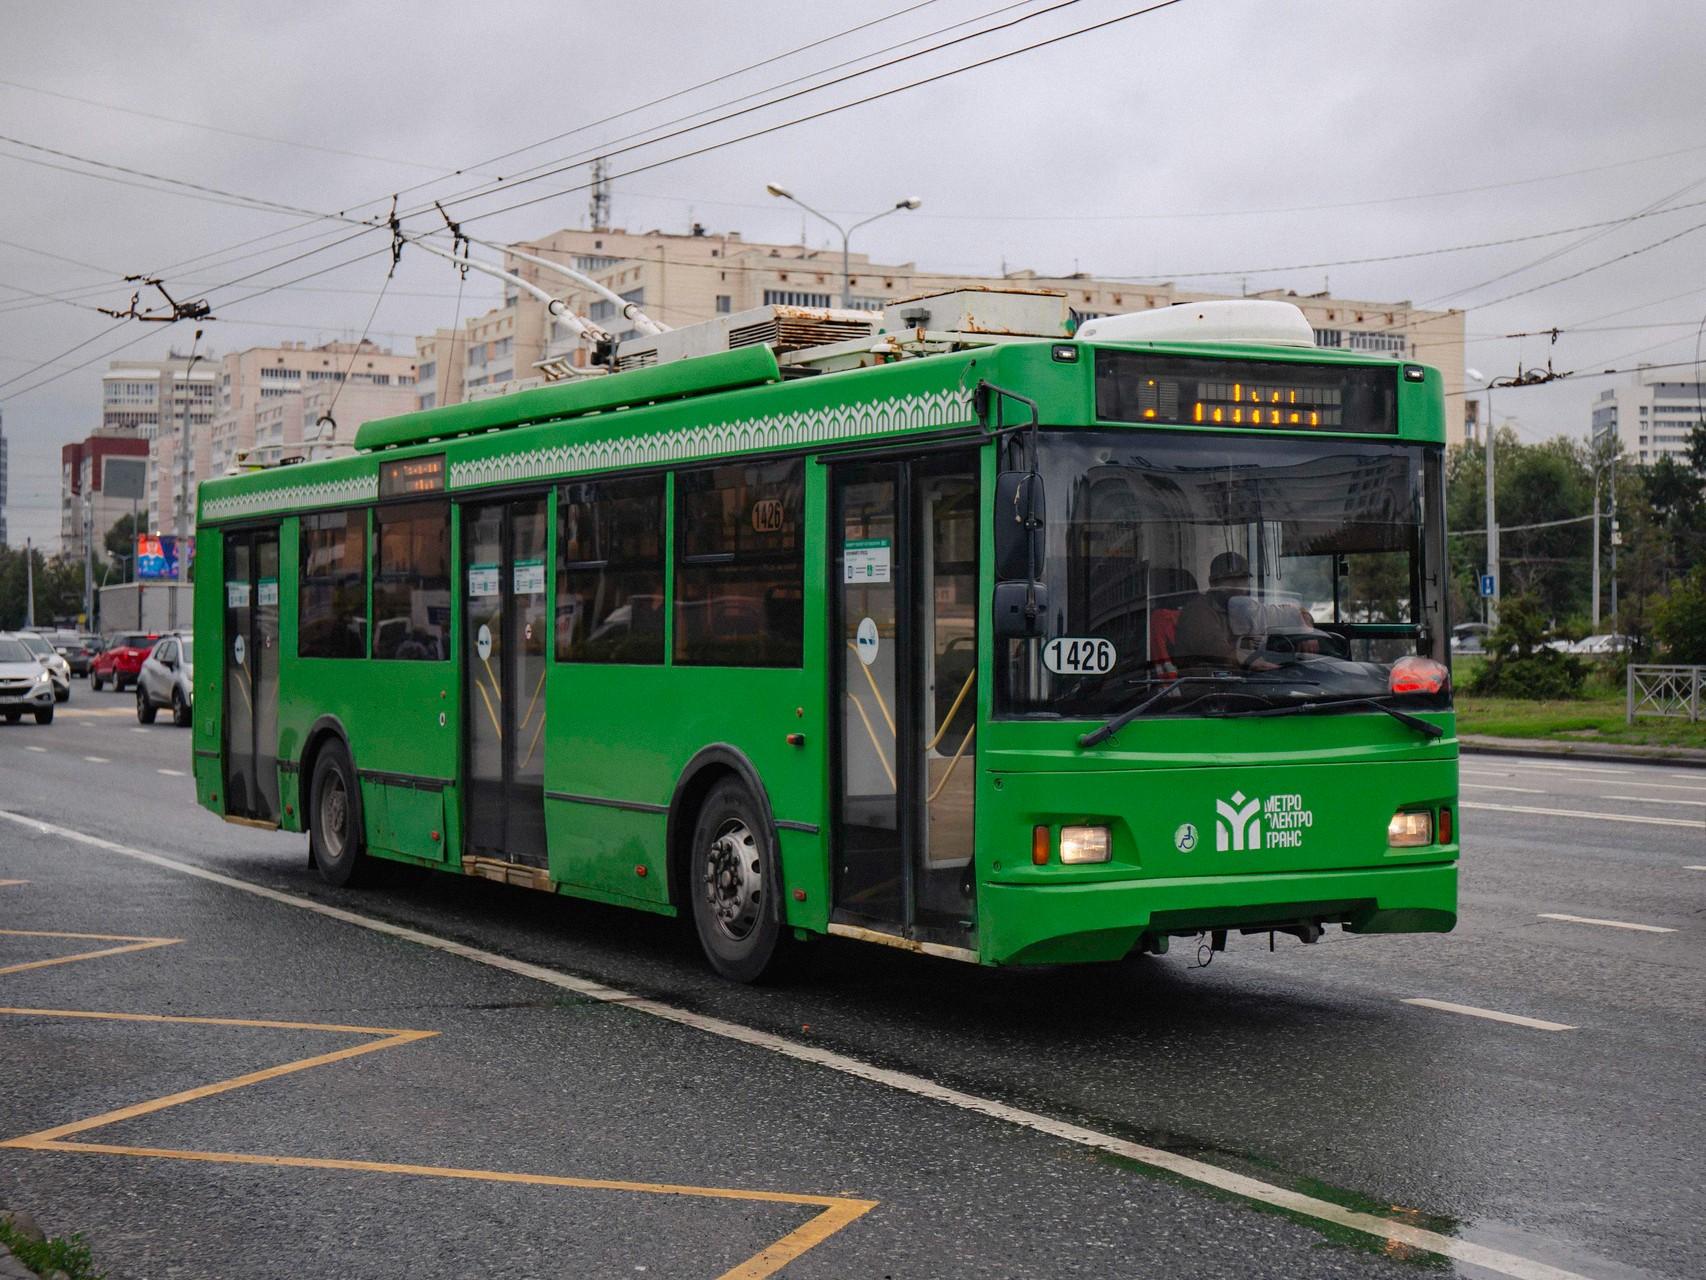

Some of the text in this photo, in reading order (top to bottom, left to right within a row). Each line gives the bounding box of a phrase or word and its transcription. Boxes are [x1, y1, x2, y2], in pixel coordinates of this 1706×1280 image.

[755, 502, 780, 528] 1426
[1052, 641, 1109, 671] 1426
[1264, 794, 1302, 812] МЕТРО
